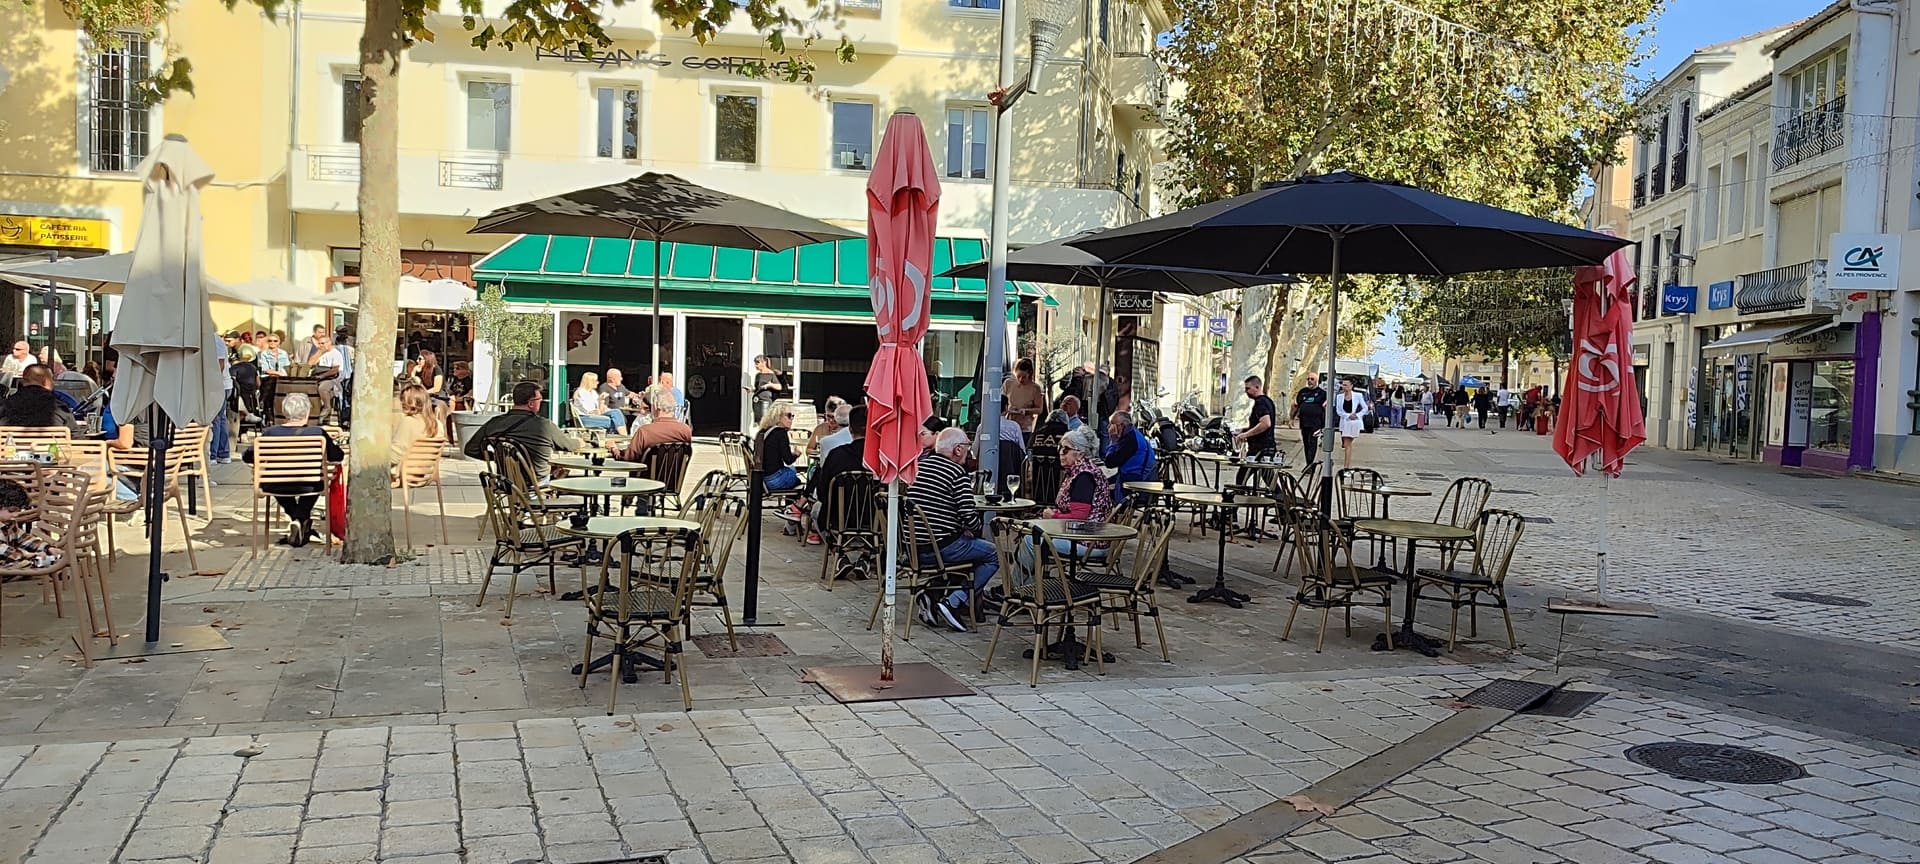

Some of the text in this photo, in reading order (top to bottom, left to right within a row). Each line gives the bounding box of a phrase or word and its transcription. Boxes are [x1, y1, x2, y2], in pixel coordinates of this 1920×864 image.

[1664, 294, 1688, 305] Krys
[1711, 287, 1728, 307] Krys
[1210, 321, 1226, 329] LCL
